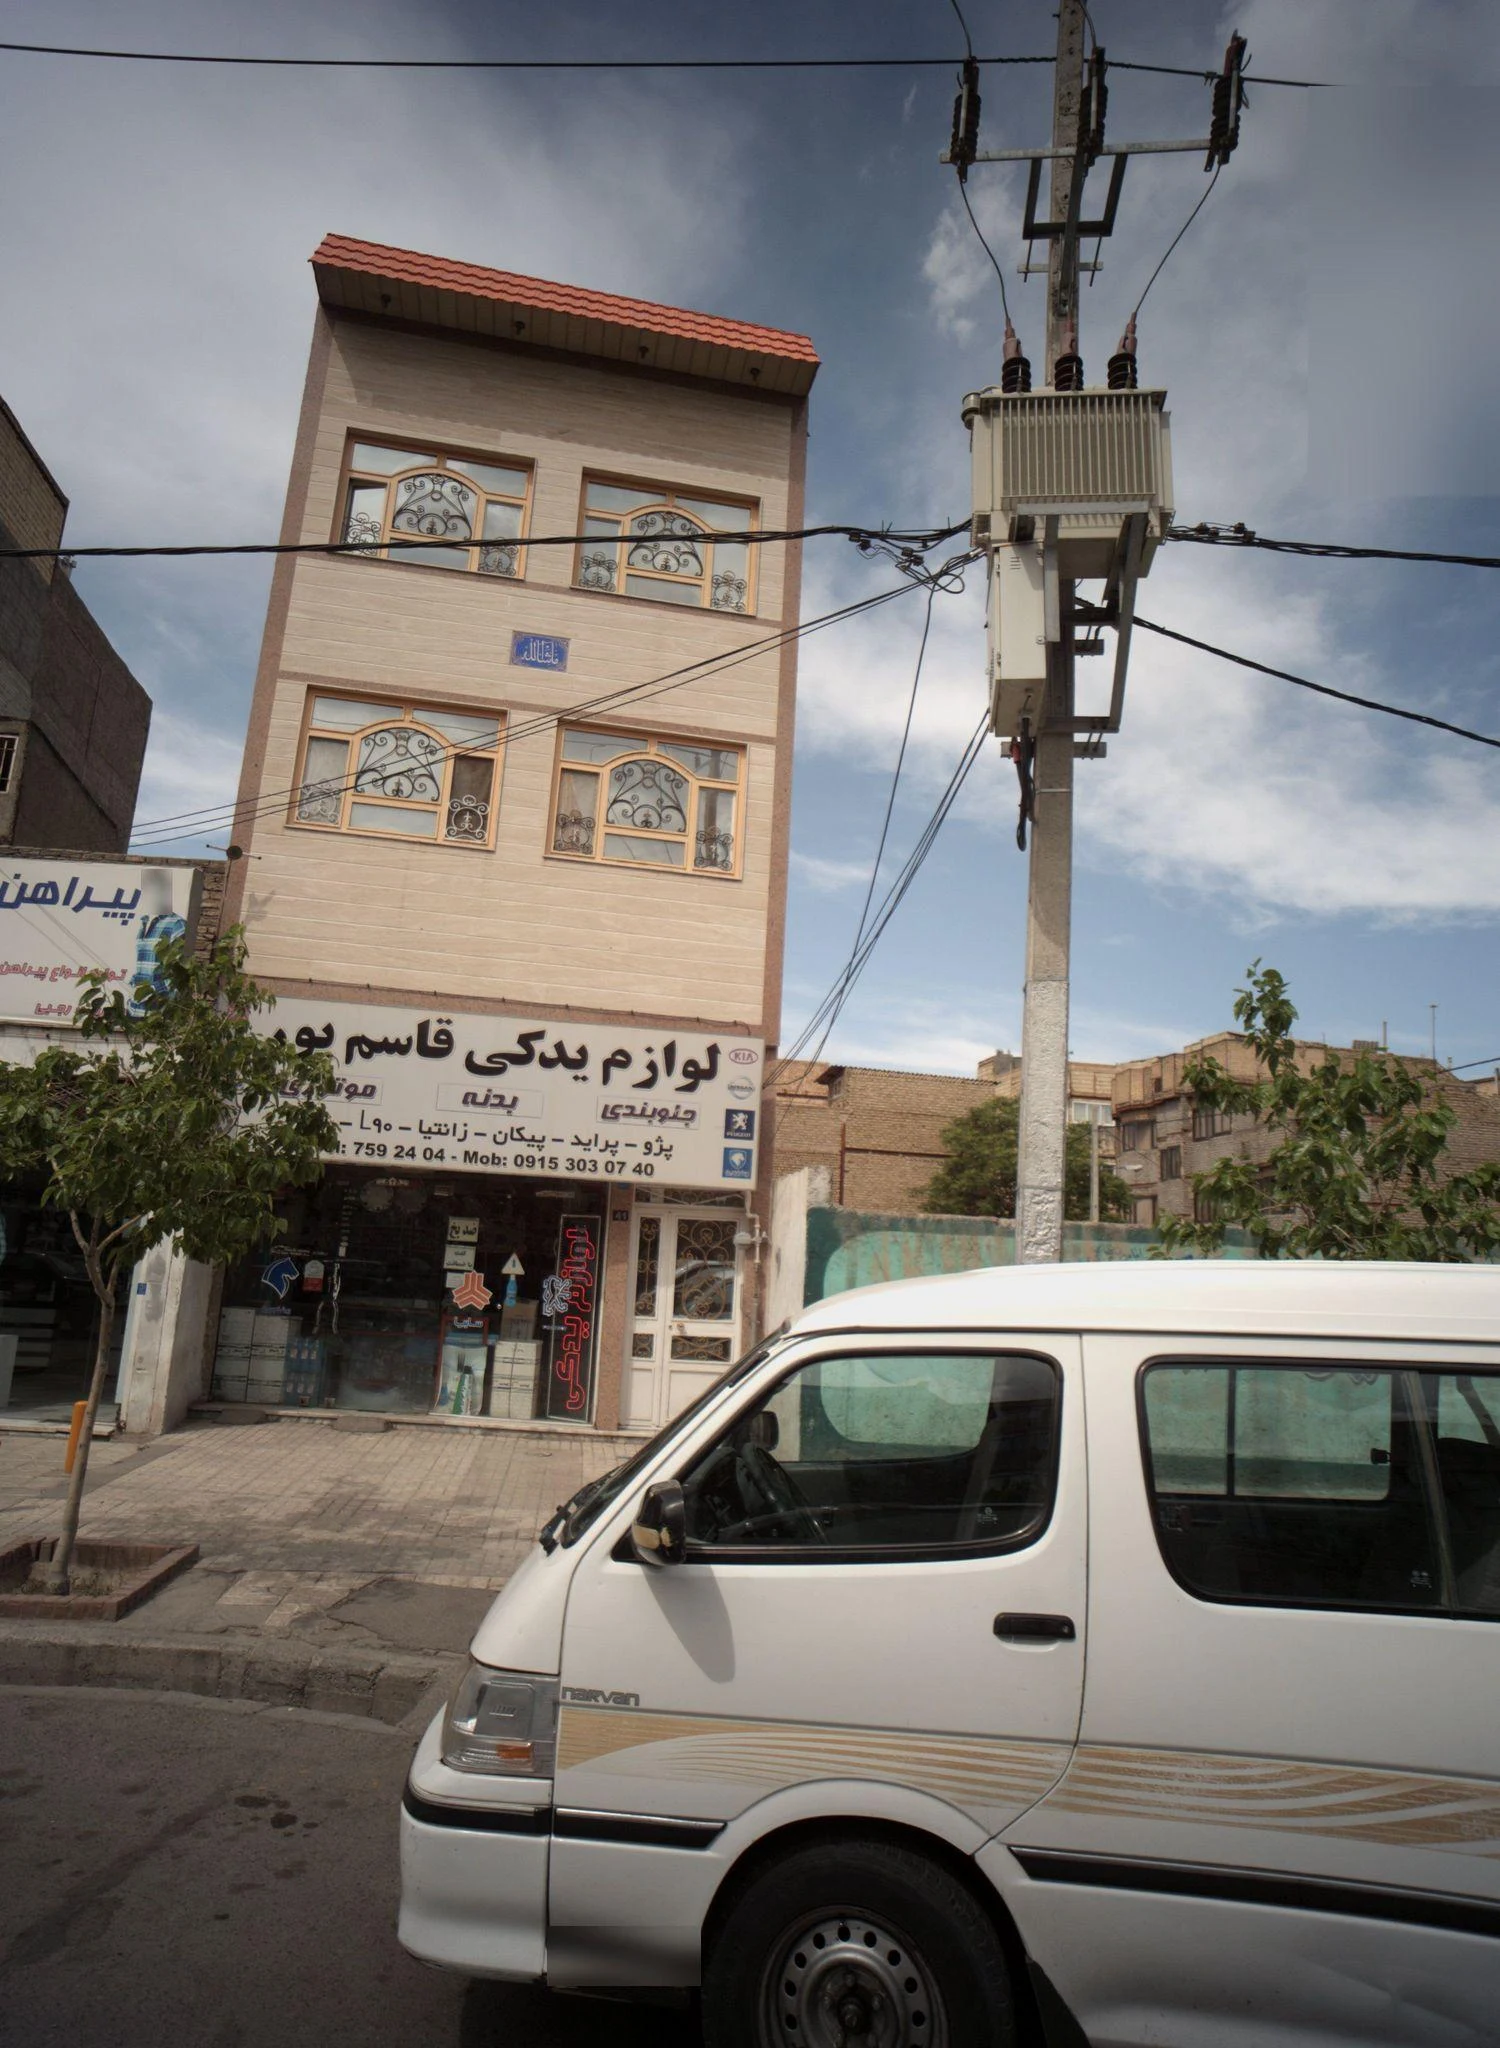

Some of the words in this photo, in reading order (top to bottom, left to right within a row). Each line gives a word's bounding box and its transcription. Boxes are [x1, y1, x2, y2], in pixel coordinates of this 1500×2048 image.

[0, 873, 142, 926] پیراهن
[345, 1018, 455, 1066] قاسم
[465, 1030, 590, 1082] یدکی
[734, 1051, 754, 1061] KIA
[602, 1040, 722, 1093] لوازم
[461, 1089, 520, 1116] بدنه
[418, 1119, 469, 1143] زانتیا
[492, 1126, 546, 1152] پیکان
[570, 1133, 620, 1157] پراید
[642, 1136, 674, 1161] پژو
[353, 1141, 388, 1157] 759
[394, 1145, 417, 1160] 24
[422, 1147, 446, 1162] 04
[463, 1151, 507, 1168] Mob:
[513, 1154, 559, 1170] 0915
[565, 1158, 599, 1173] 303
[604, 1161, 627, 1175] 07
[632, 1162, 655, 1177] 40
[560, 1226, 595, 1313] لوازم
[556, 1316, 590, 1411] یدکی
